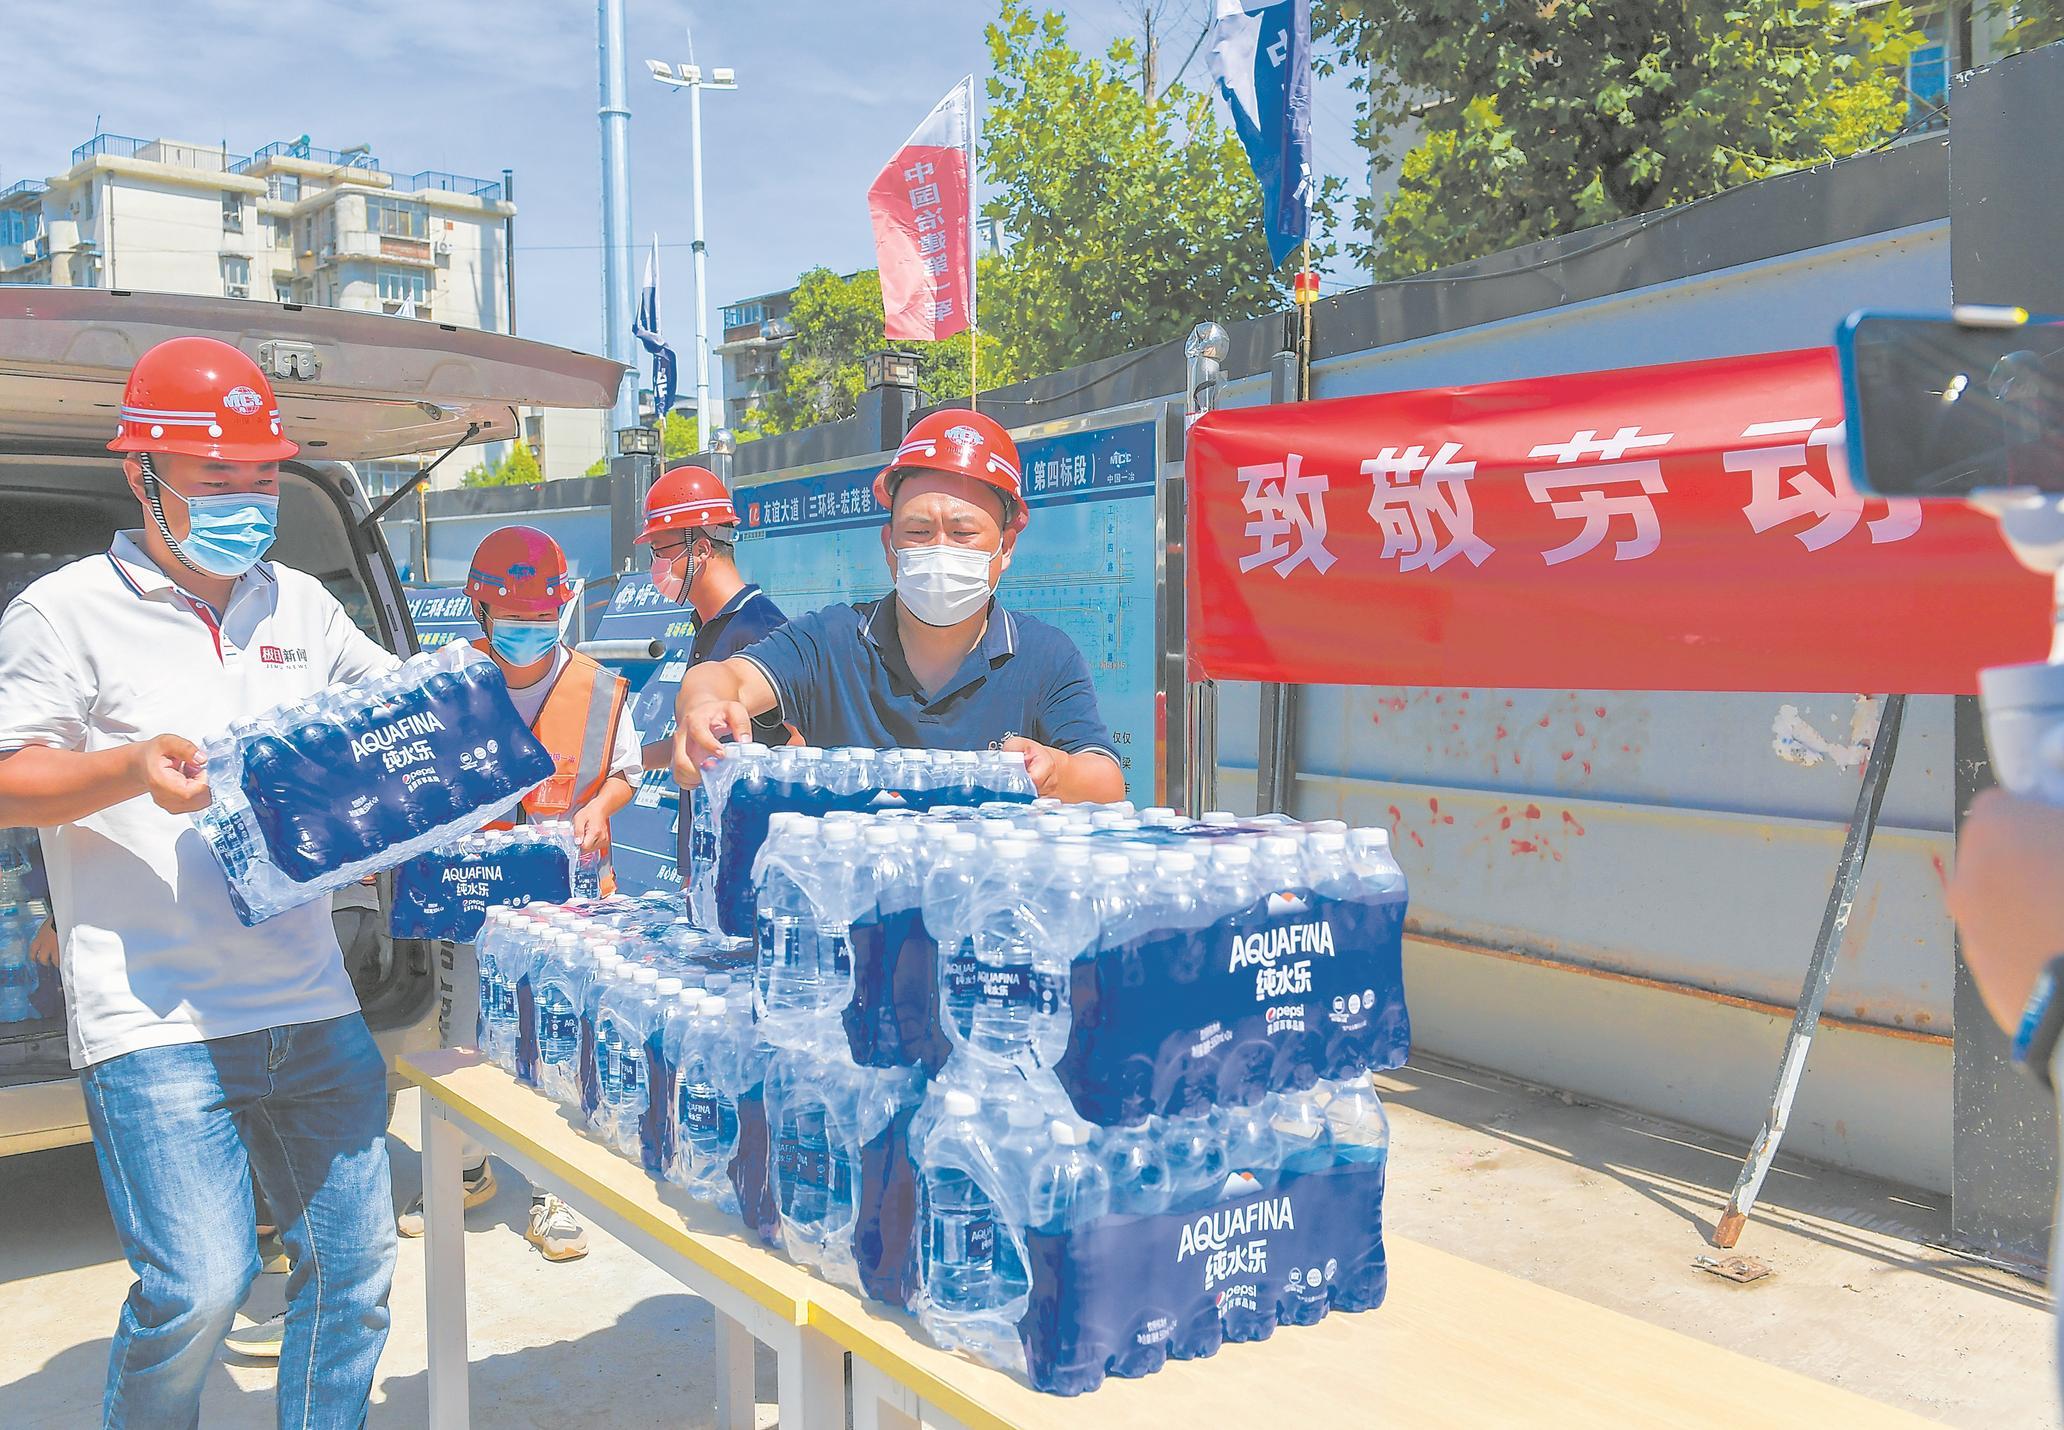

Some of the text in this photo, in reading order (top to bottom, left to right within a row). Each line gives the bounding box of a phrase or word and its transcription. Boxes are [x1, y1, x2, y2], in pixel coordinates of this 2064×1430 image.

[1107, 471, 1135, 484] 中国一冶
[260, 646, 307, 664] 极目新闻
[351, 711, 446, 762] AQUAFINA
[382, 740, 436, 773] 纯水乐
[411, 767, 436, 782] pepsi
[442, 866, 503, 883] AQUAFINA
[456, 882, 489, 897] 纯水乐
[1229, 921, 1335, 973] AQUAFINA
[1256, 960, 1312, 1001] 纯水乐
[1277, 1004, 1304, 1020] pepsi
[1177, 1196, 1295, 1263] AQUAFINA
[1204, 1239, 1267, 1291] 纯水乐
[1225, 1284, 1257, 1302] pepsi
